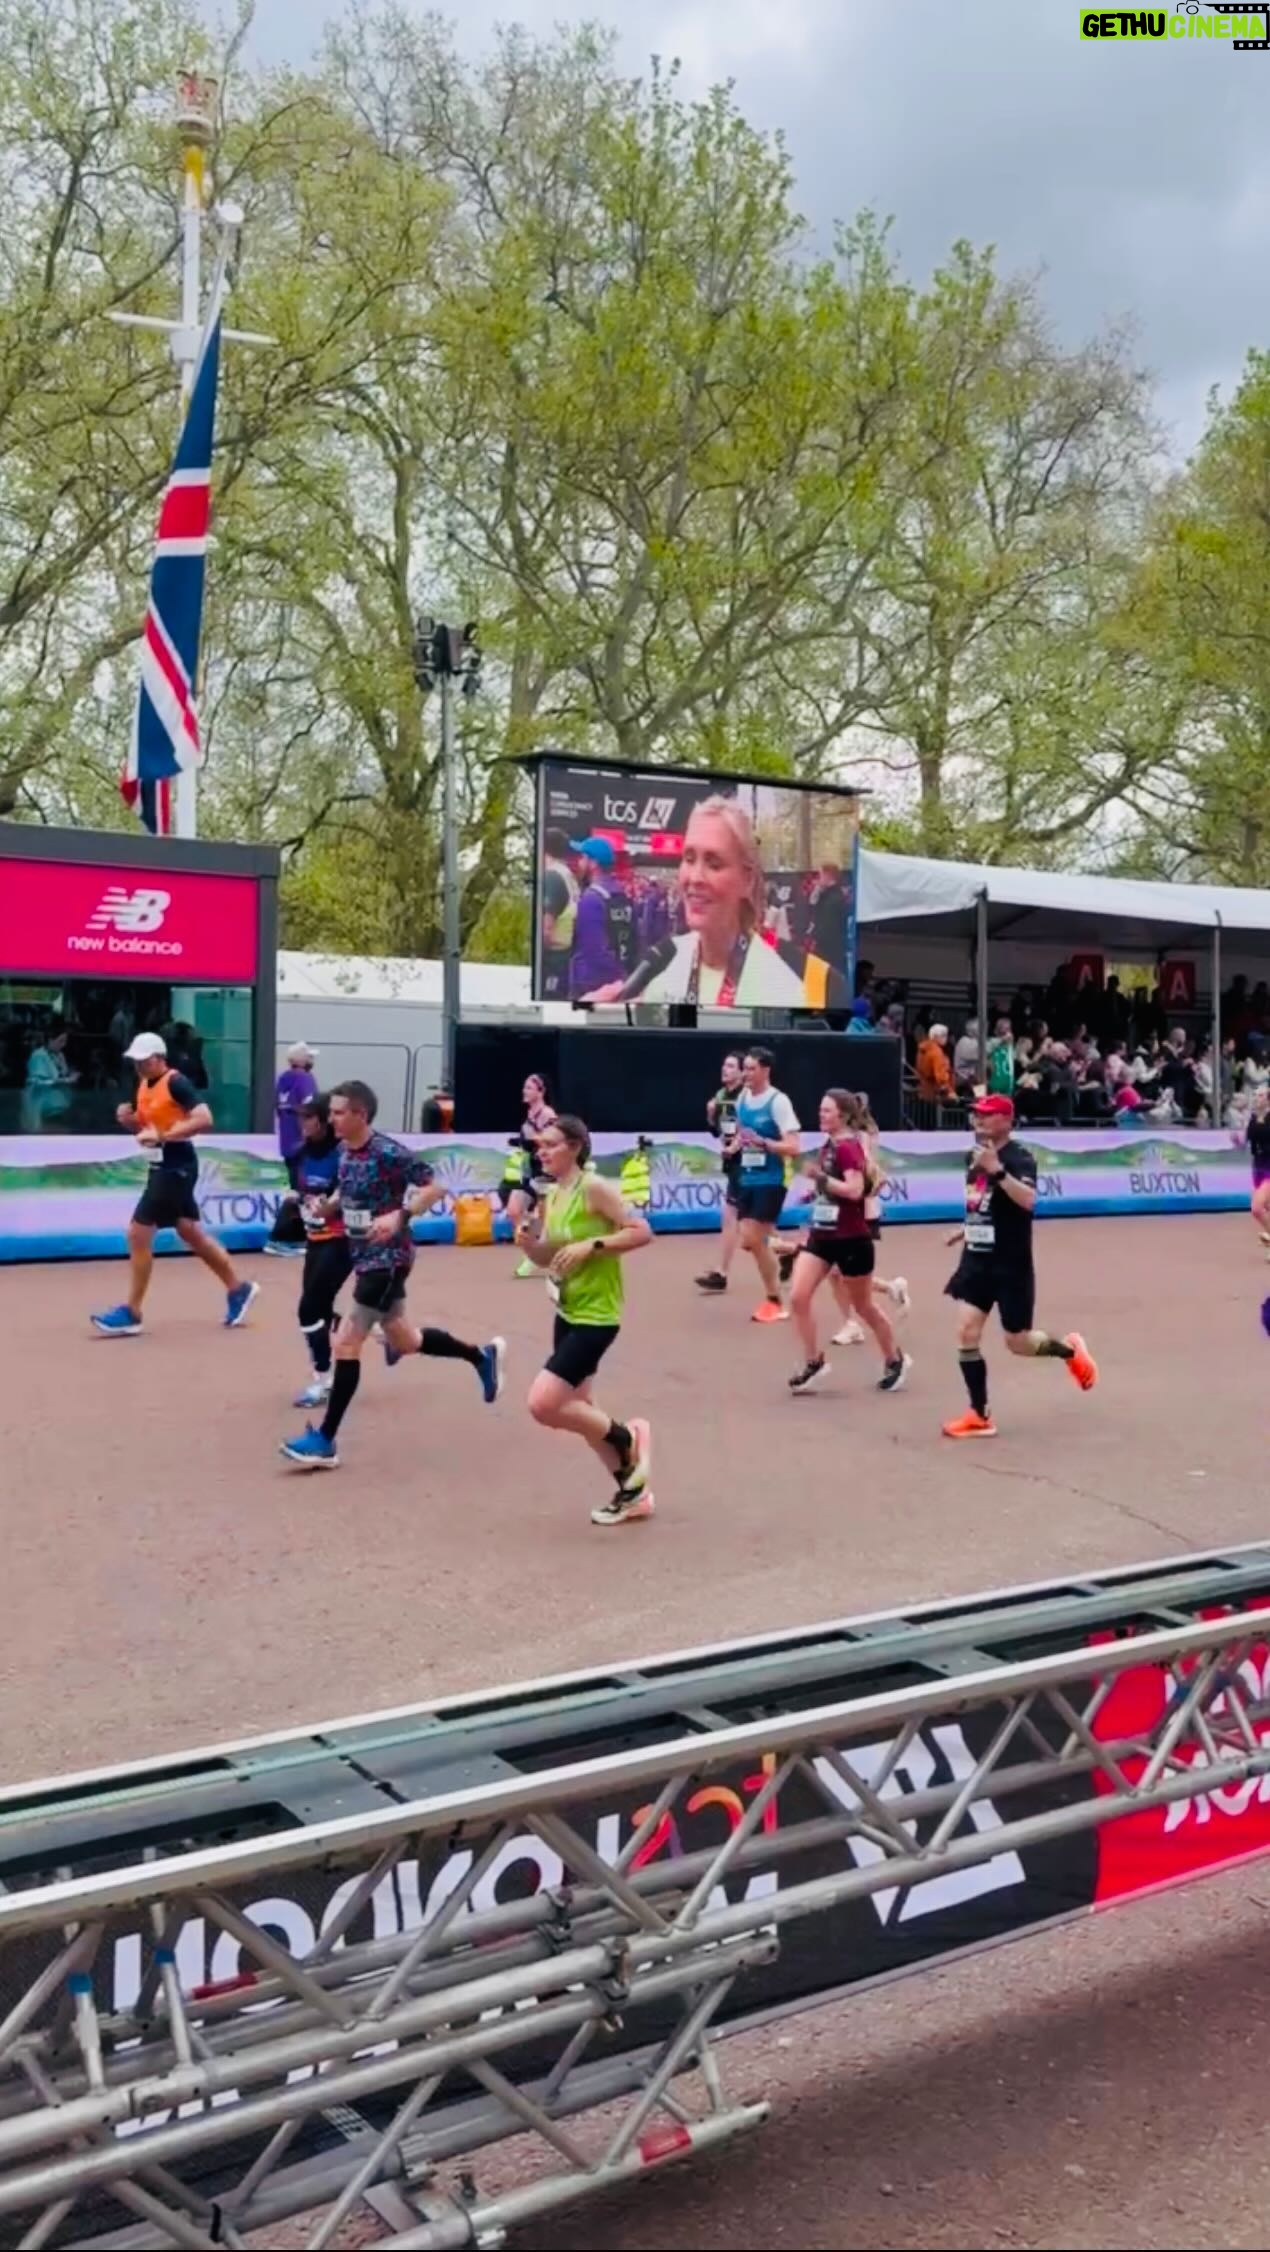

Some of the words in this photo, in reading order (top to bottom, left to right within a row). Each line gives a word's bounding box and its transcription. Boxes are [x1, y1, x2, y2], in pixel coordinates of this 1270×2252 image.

[603, 794, 637, 823] tcs
[67, 936, 105, 951] new
[108, 936, 182, 955] balance
[1169, 968, 1189, 1001] A
[648, 1183, 723, 1209] UXTO
[1129, 1172, 1200, 1194] BUXTON
[200, 1193, 281, 1224] XTON
